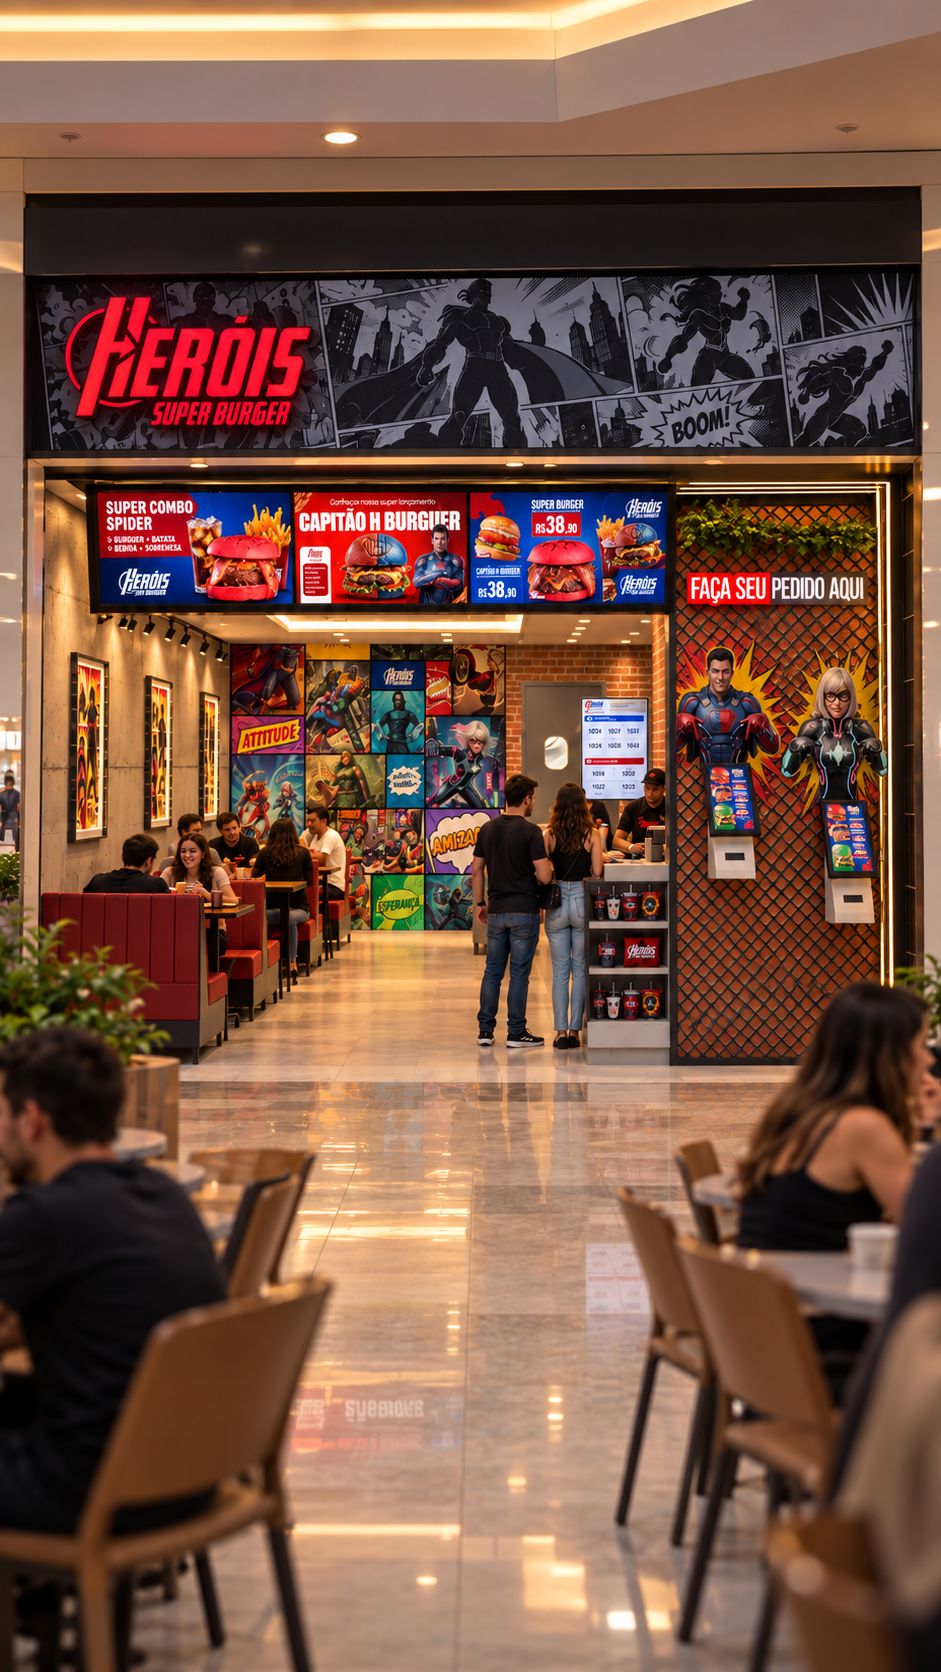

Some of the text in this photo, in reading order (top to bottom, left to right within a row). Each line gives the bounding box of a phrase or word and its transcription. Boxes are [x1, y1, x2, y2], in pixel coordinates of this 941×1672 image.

[151, 401, 291, 425] SUPER BURGER
[671, 406, 730, 444] BOOM!
[106, 500, 193, 514] SUPER COMBO
[329, 498, 359, 506] Conheça
[398, 498, 436, 507] lançamento
[531, 499, 584, 510] SUPER BURGER
[626, 498, 662, 518] HERÓIS
[106, 516, 152, 531] SPIDER
[298, 508, 461, 532] CAPITÃO H BURGUER
[120, 568, 171, 595] HERÓIS
[621, 575, 657, 595] HERÓIS
[690, 576, 864, 604] FAÇA SEU PEDIDO AQUI
[242, 724, 297, 749] ATTITUDE
